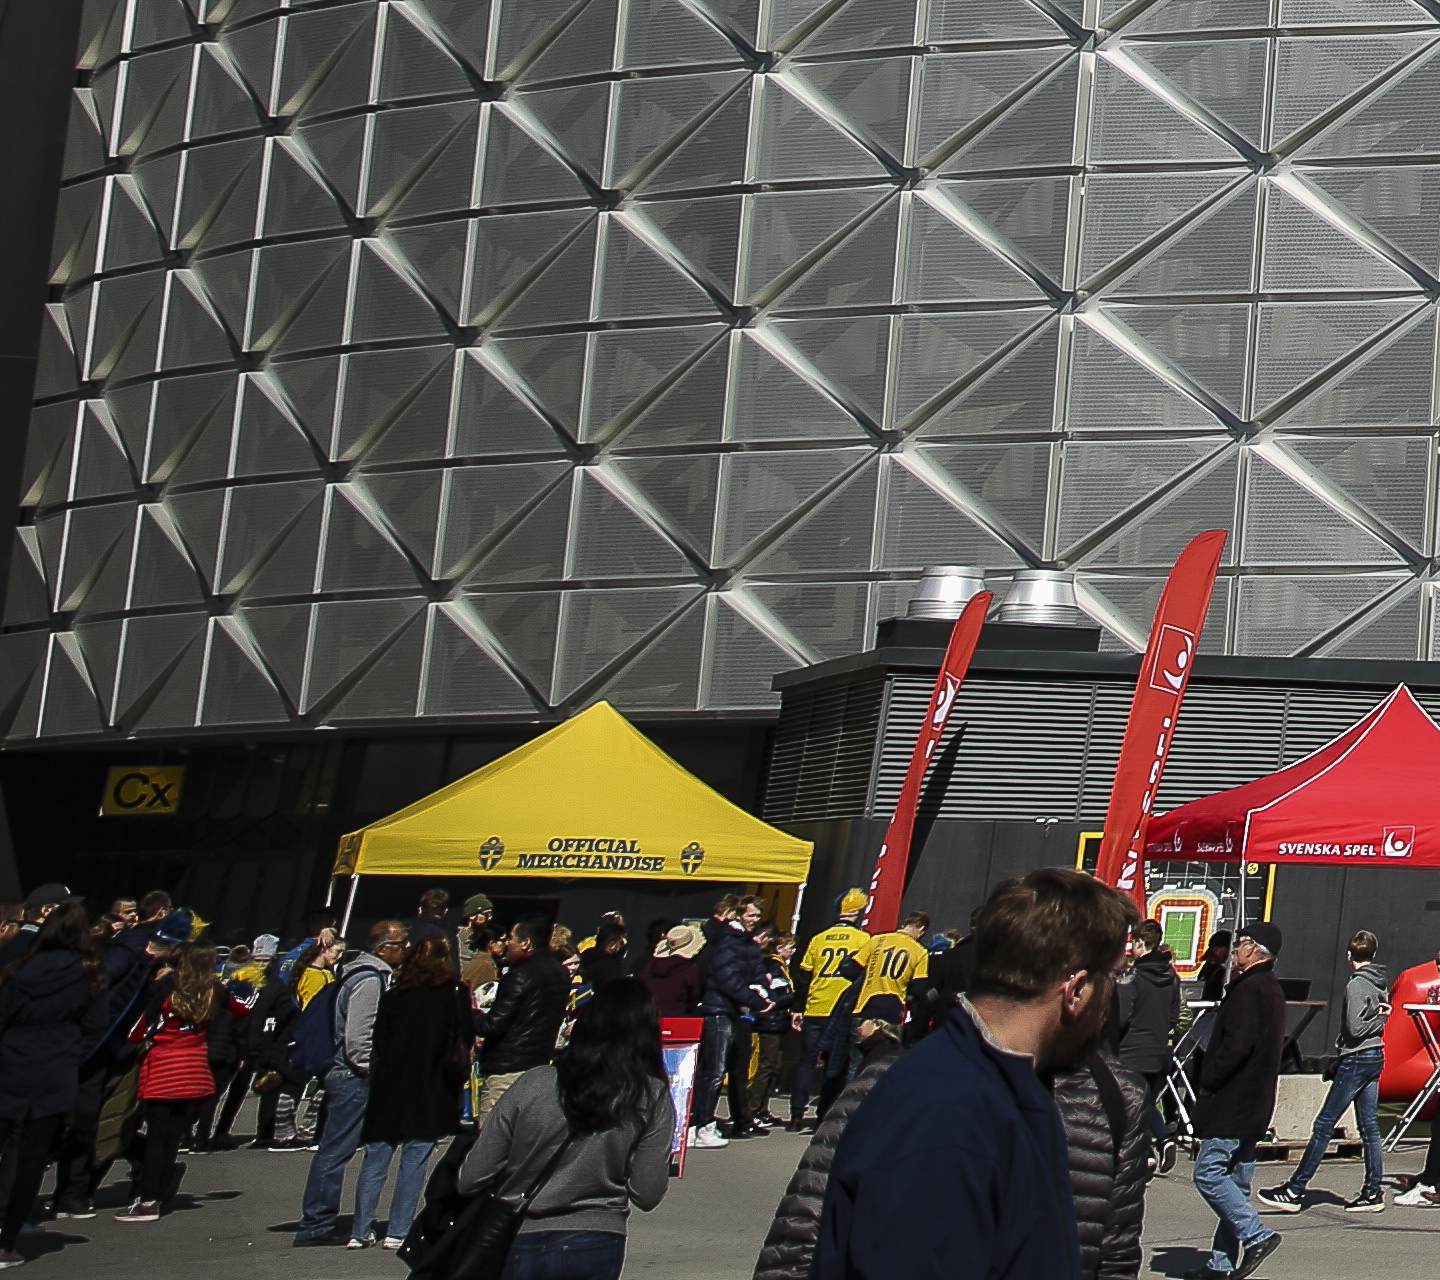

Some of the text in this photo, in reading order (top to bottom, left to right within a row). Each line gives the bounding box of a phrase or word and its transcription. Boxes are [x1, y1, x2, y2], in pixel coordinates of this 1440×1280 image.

[113, 772, 175, 809] Cx
[548, 837, 642, 854] OFFICIAL
[1278, 842, 1377, 857] SVENSKA SPEL
[516, 853, 666, 872] MERCHANDISE
[880, 945, 911, 980] 10
